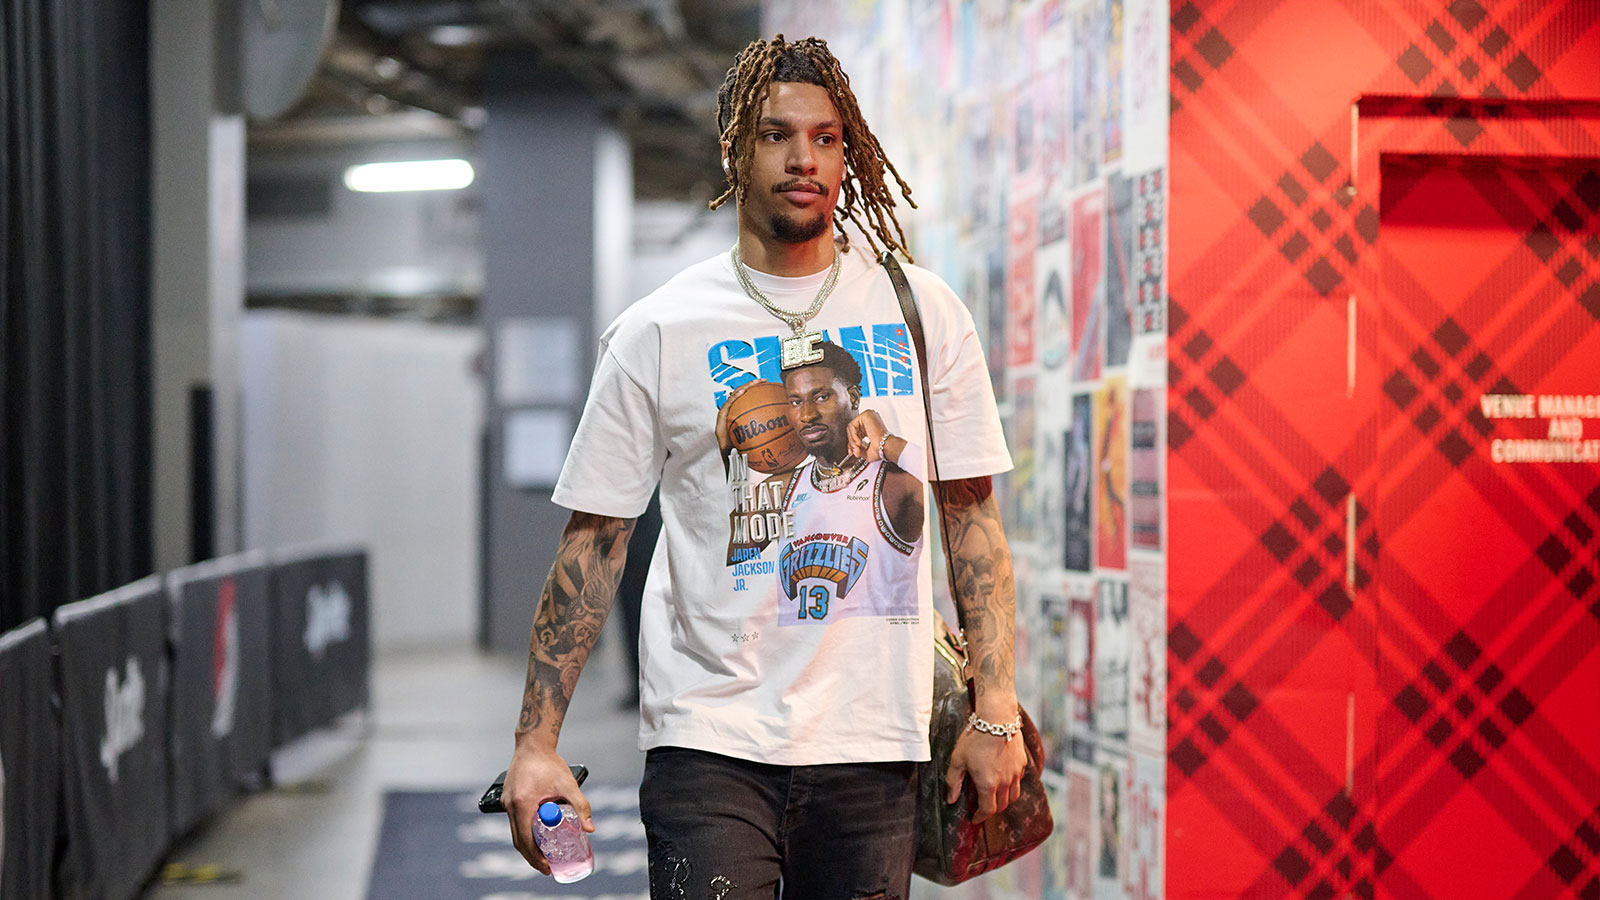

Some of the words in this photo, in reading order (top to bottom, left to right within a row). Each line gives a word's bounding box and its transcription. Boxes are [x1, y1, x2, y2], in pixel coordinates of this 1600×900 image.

[1480, 394, 1536, 418] VENUE
[732, 413, 789, 445] Wilson
[1548, 417, 1583, 440] AND
[728, 448, 749, 482] IN
[732, 480, 784, 513] THAT
[733, 510, 796, 544] MODE
[792, 533, 849, 549] VANCOUVER
[731, 547, 762, 562] JAREN
[778, 536, 869, 601] GRIZZLIES
[732, 561, 775, 577] JACKSON
[733, 579, 749, 592] JR.
[798, 585, 830, 620] 13
